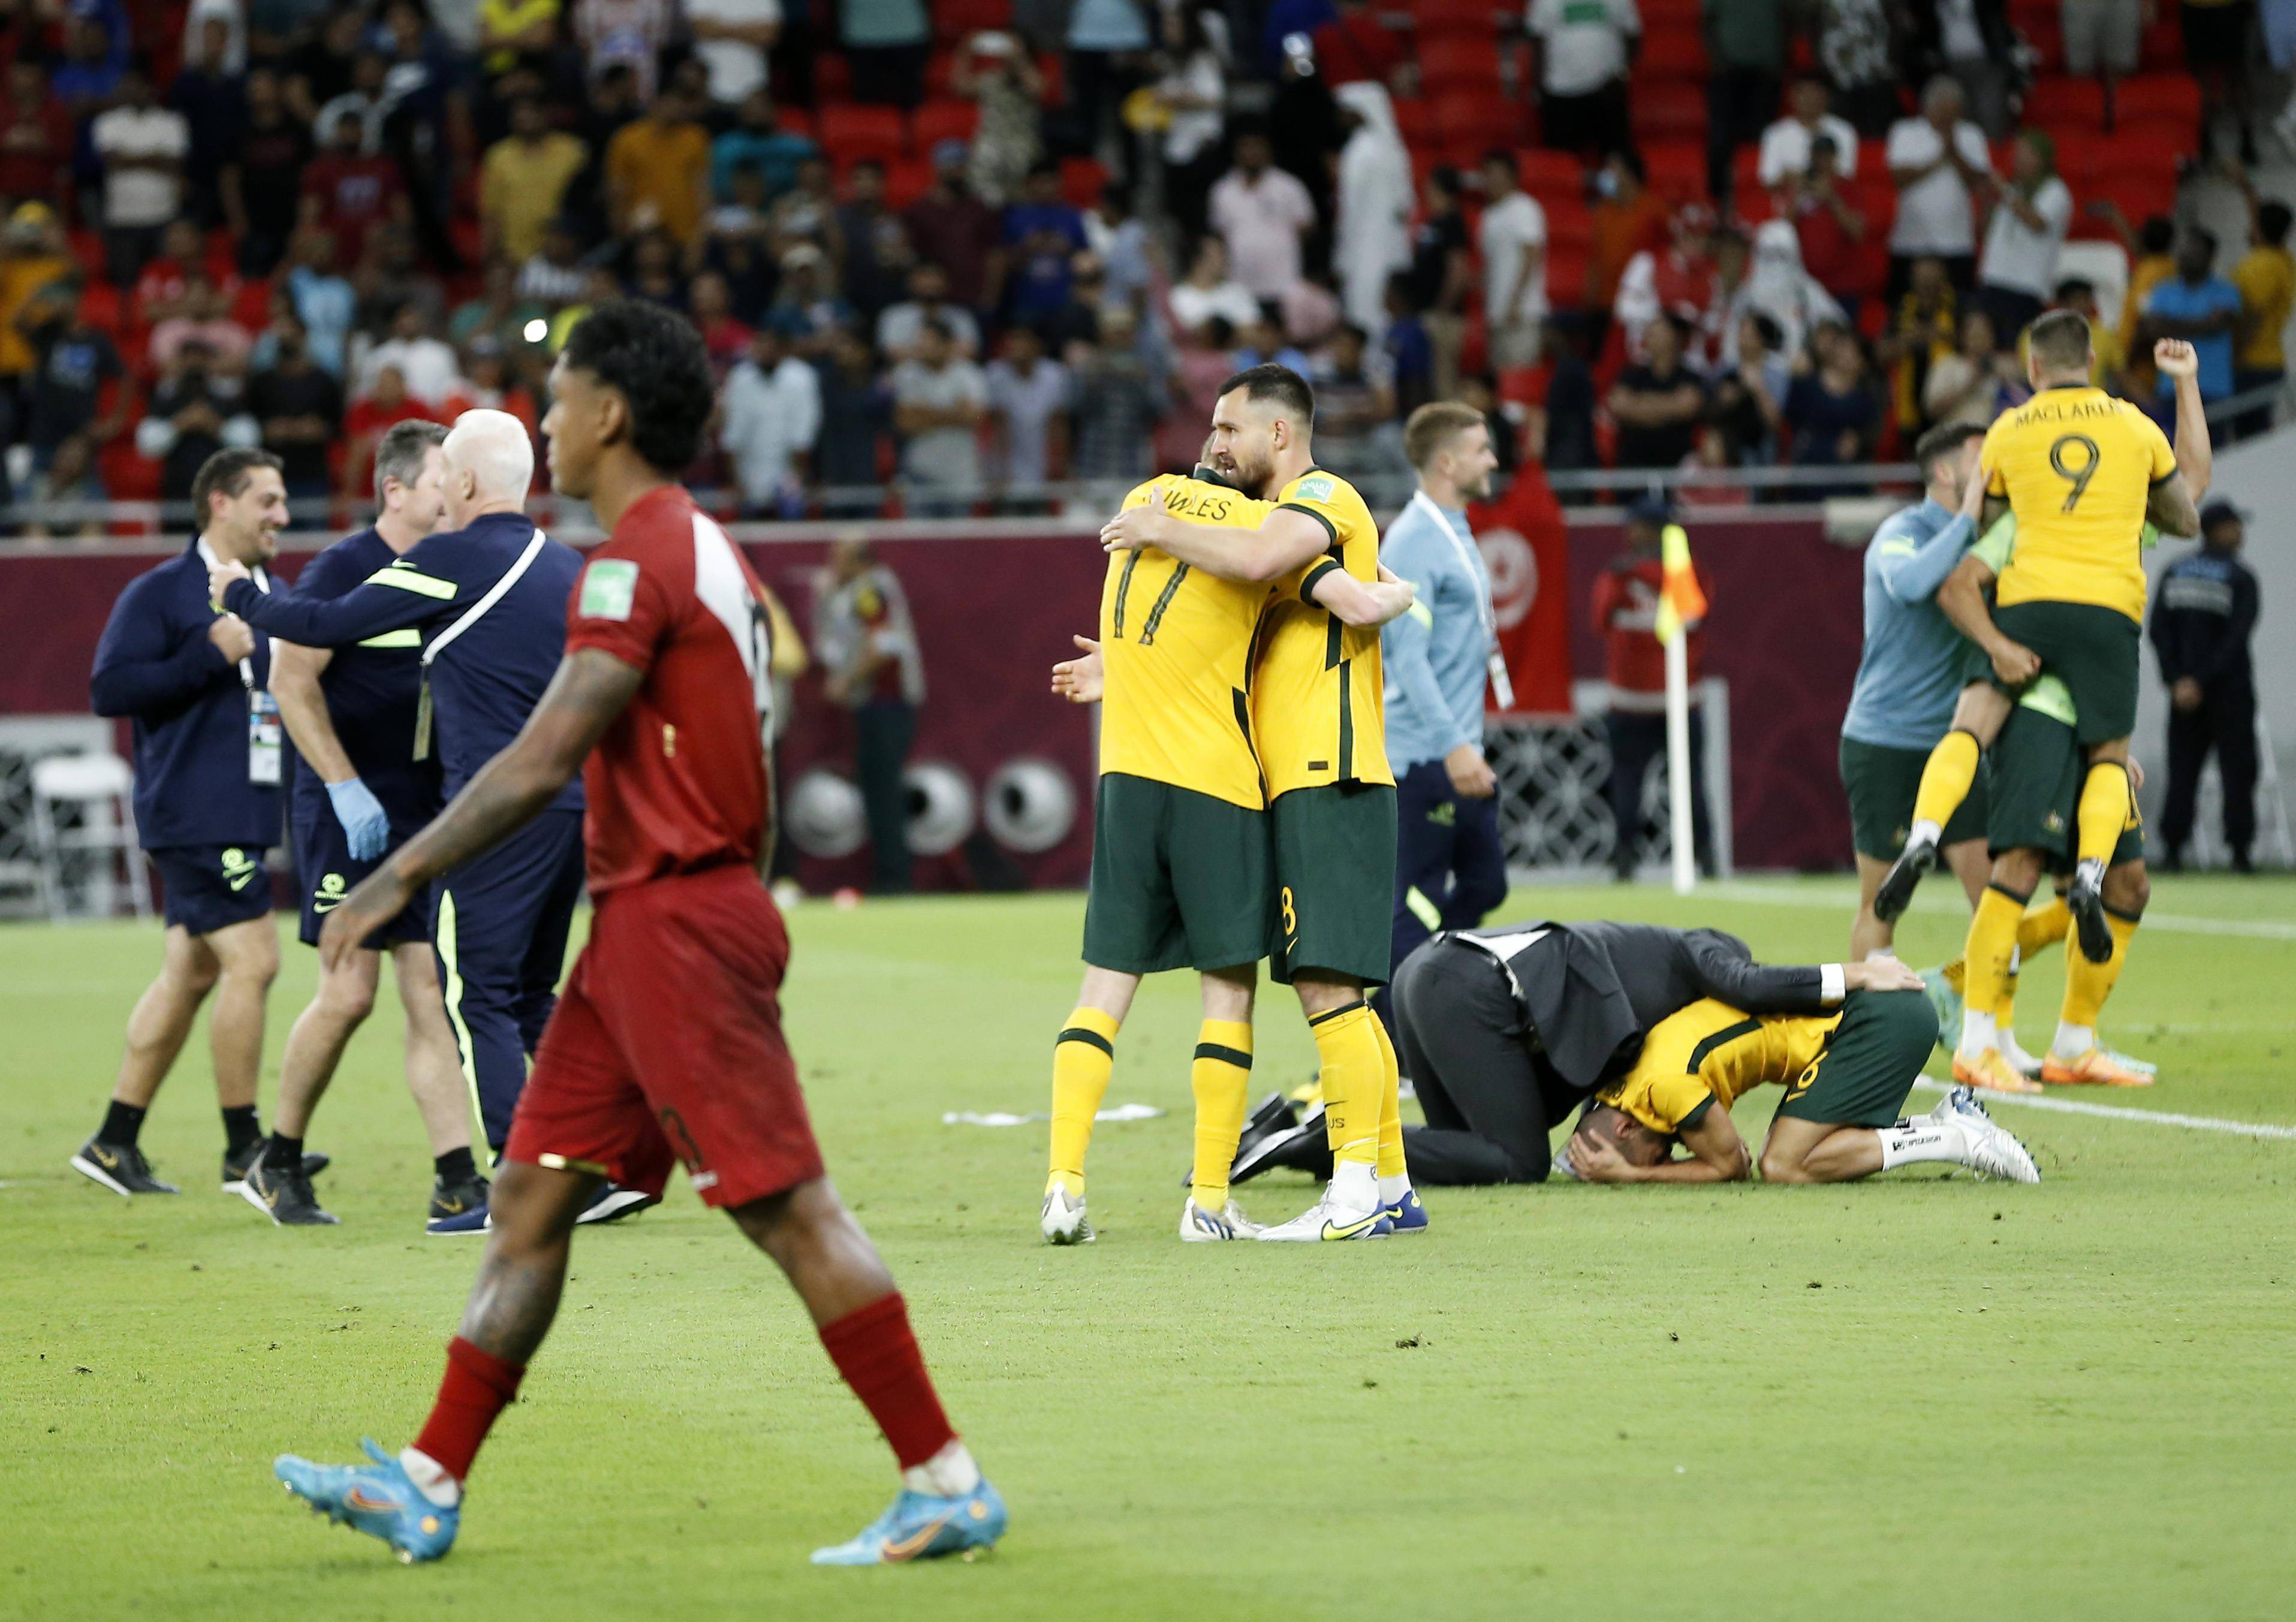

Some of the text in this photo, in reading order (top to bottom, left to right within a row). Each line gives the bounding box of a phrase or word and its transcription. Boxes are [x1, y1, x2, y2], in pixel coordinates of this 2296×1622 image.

[2050, 435, 2099, 515] 9
[1143, 489, 1231, 521] WLES
[1113, 550, 1191, 645] 17
[1281, 886, 1297, 936] 8
[1328, 1118, 1345, 1129] US
